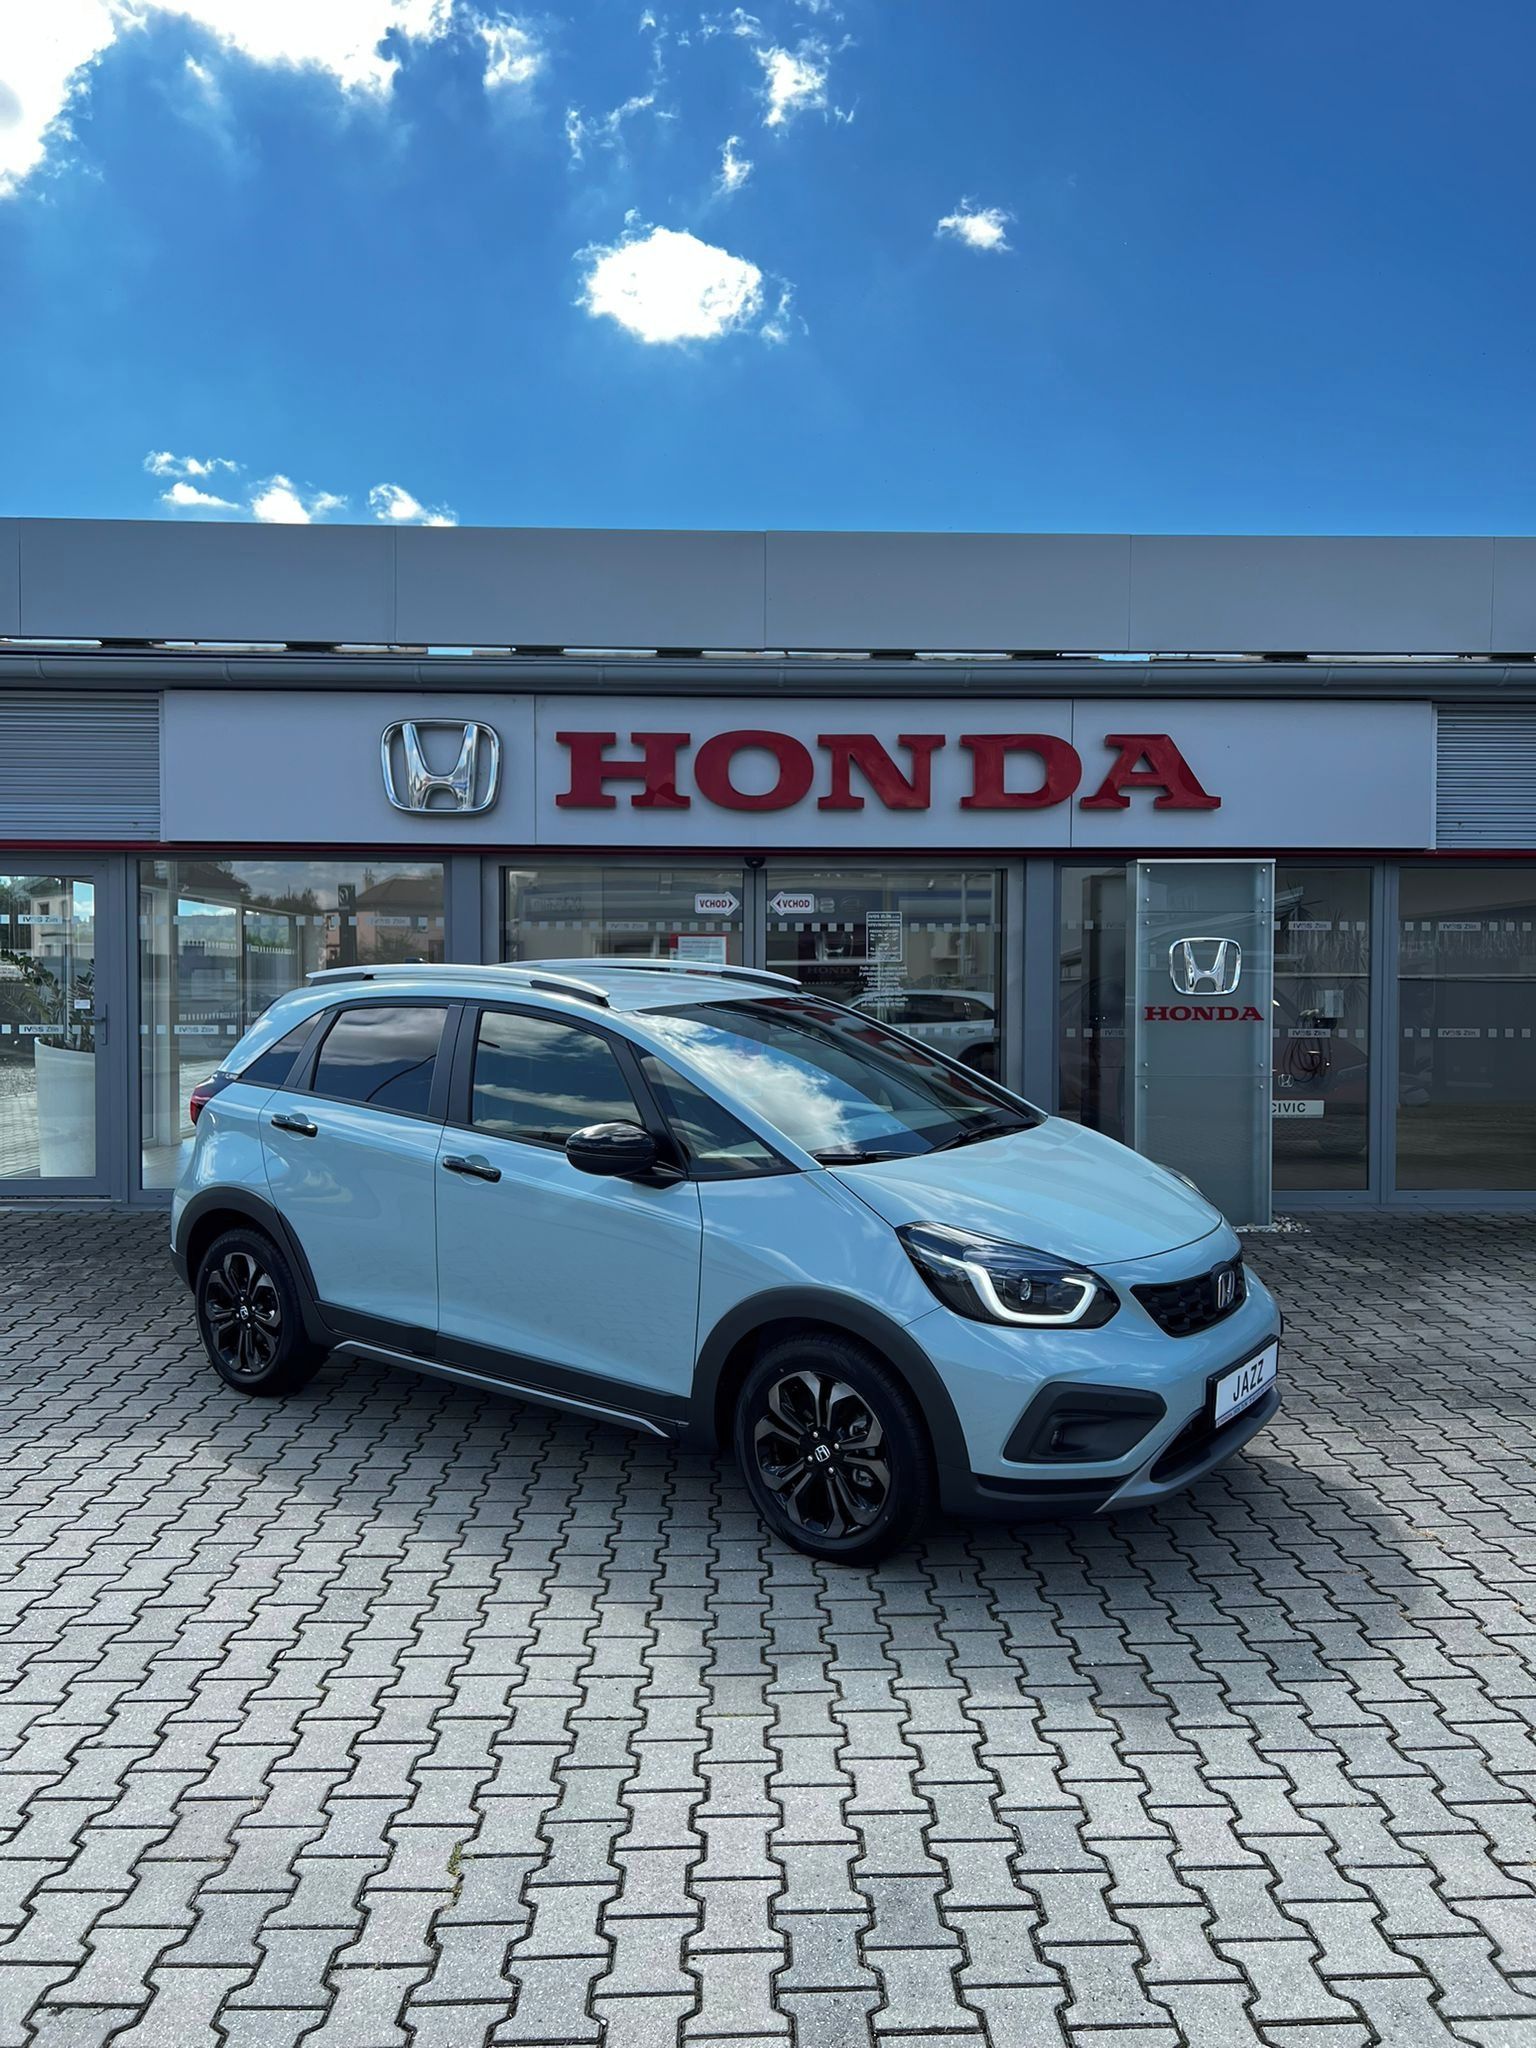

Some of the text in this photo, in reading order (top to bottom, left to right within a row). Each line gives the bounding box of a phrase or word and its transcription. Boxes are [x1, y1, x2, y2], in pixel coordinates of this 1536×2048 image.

[555, 729, 1222, 811] HONDA
[699, 900, 727, 908] VCHOD
[782, 900, 810, 908] VCHOD
[1144, 1006, 1264, 1021] HONDA
[1233, 1358, 1264, 1402] JAZZ
